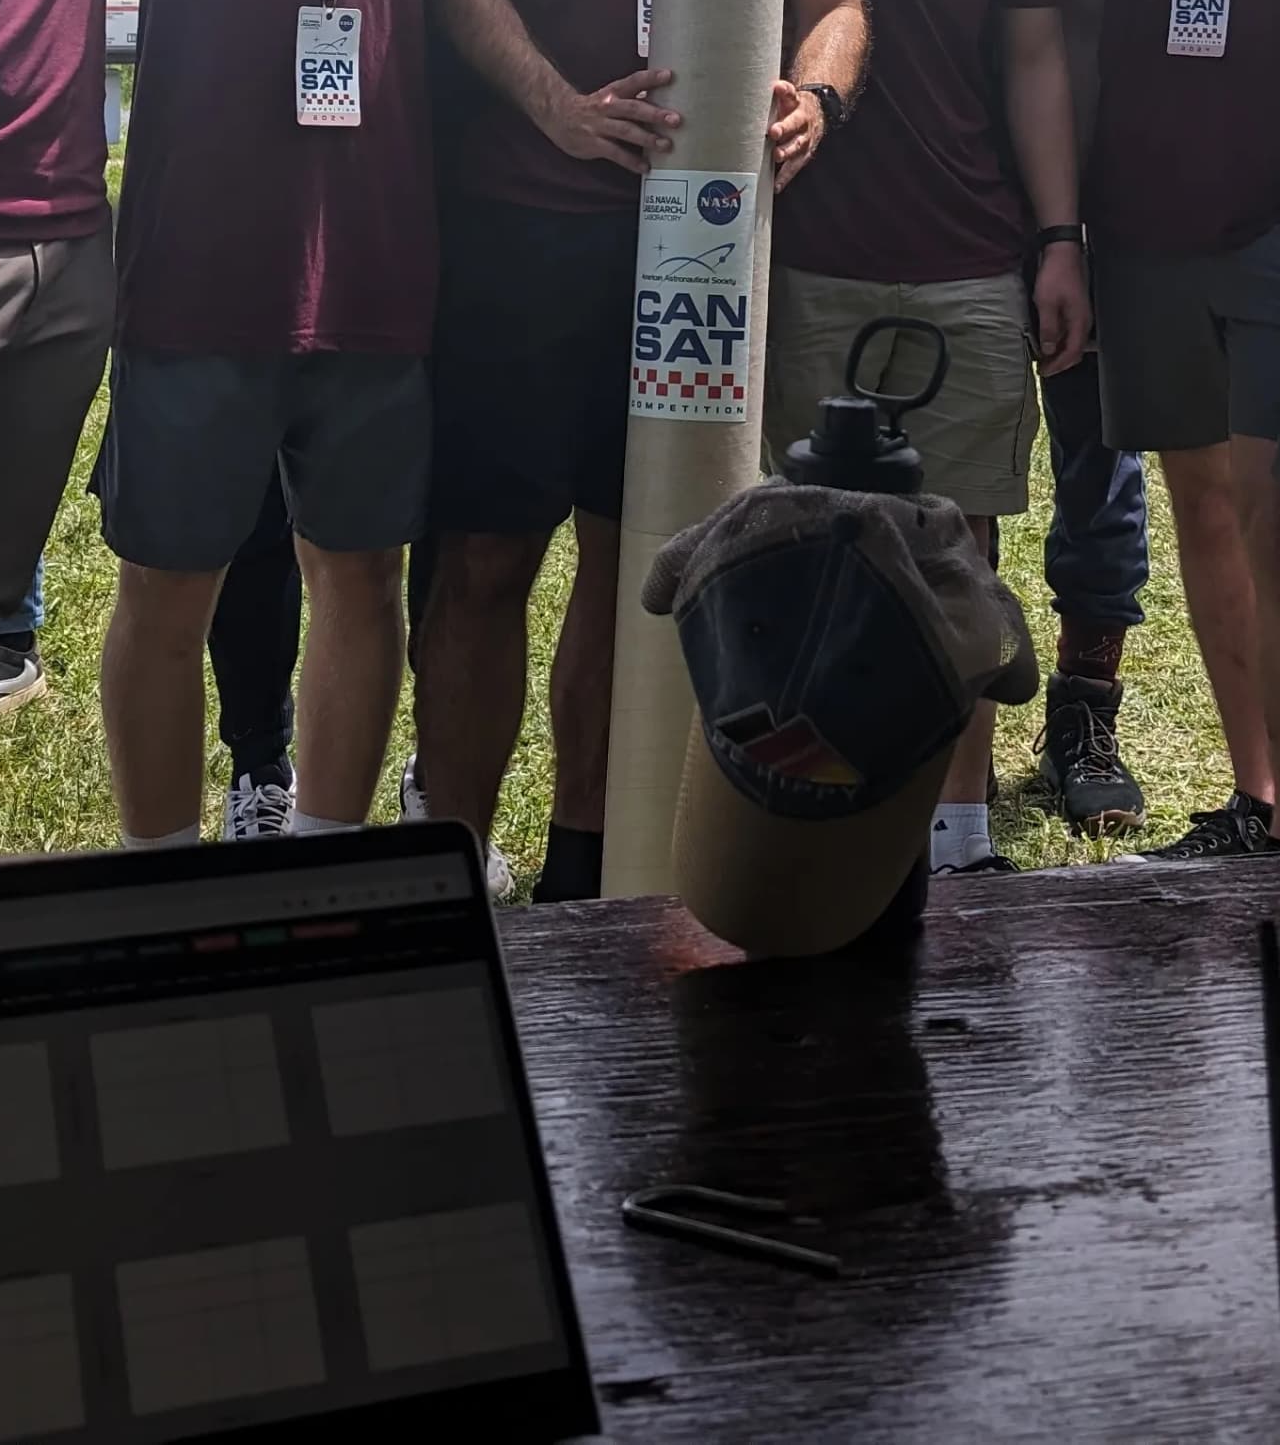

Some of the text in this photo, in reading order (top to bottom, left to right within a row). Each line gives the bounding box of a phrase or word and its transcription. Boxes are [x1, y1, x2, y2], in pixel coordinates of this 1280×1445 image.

[1175, 11, 1223, 25] SAT
[301, 58, 353, 75] CAN
[301, 74, 353, 91] SAT
[656, 196, 683, 206] NAVAL
[700, 196, 739, 209] NASA
[711, 276, 737, 286] Society
[636, 290, 747, 328] CAN
[635, 326, 745, 366] SAT
[631, 400, 744, 414] COMPETITION
